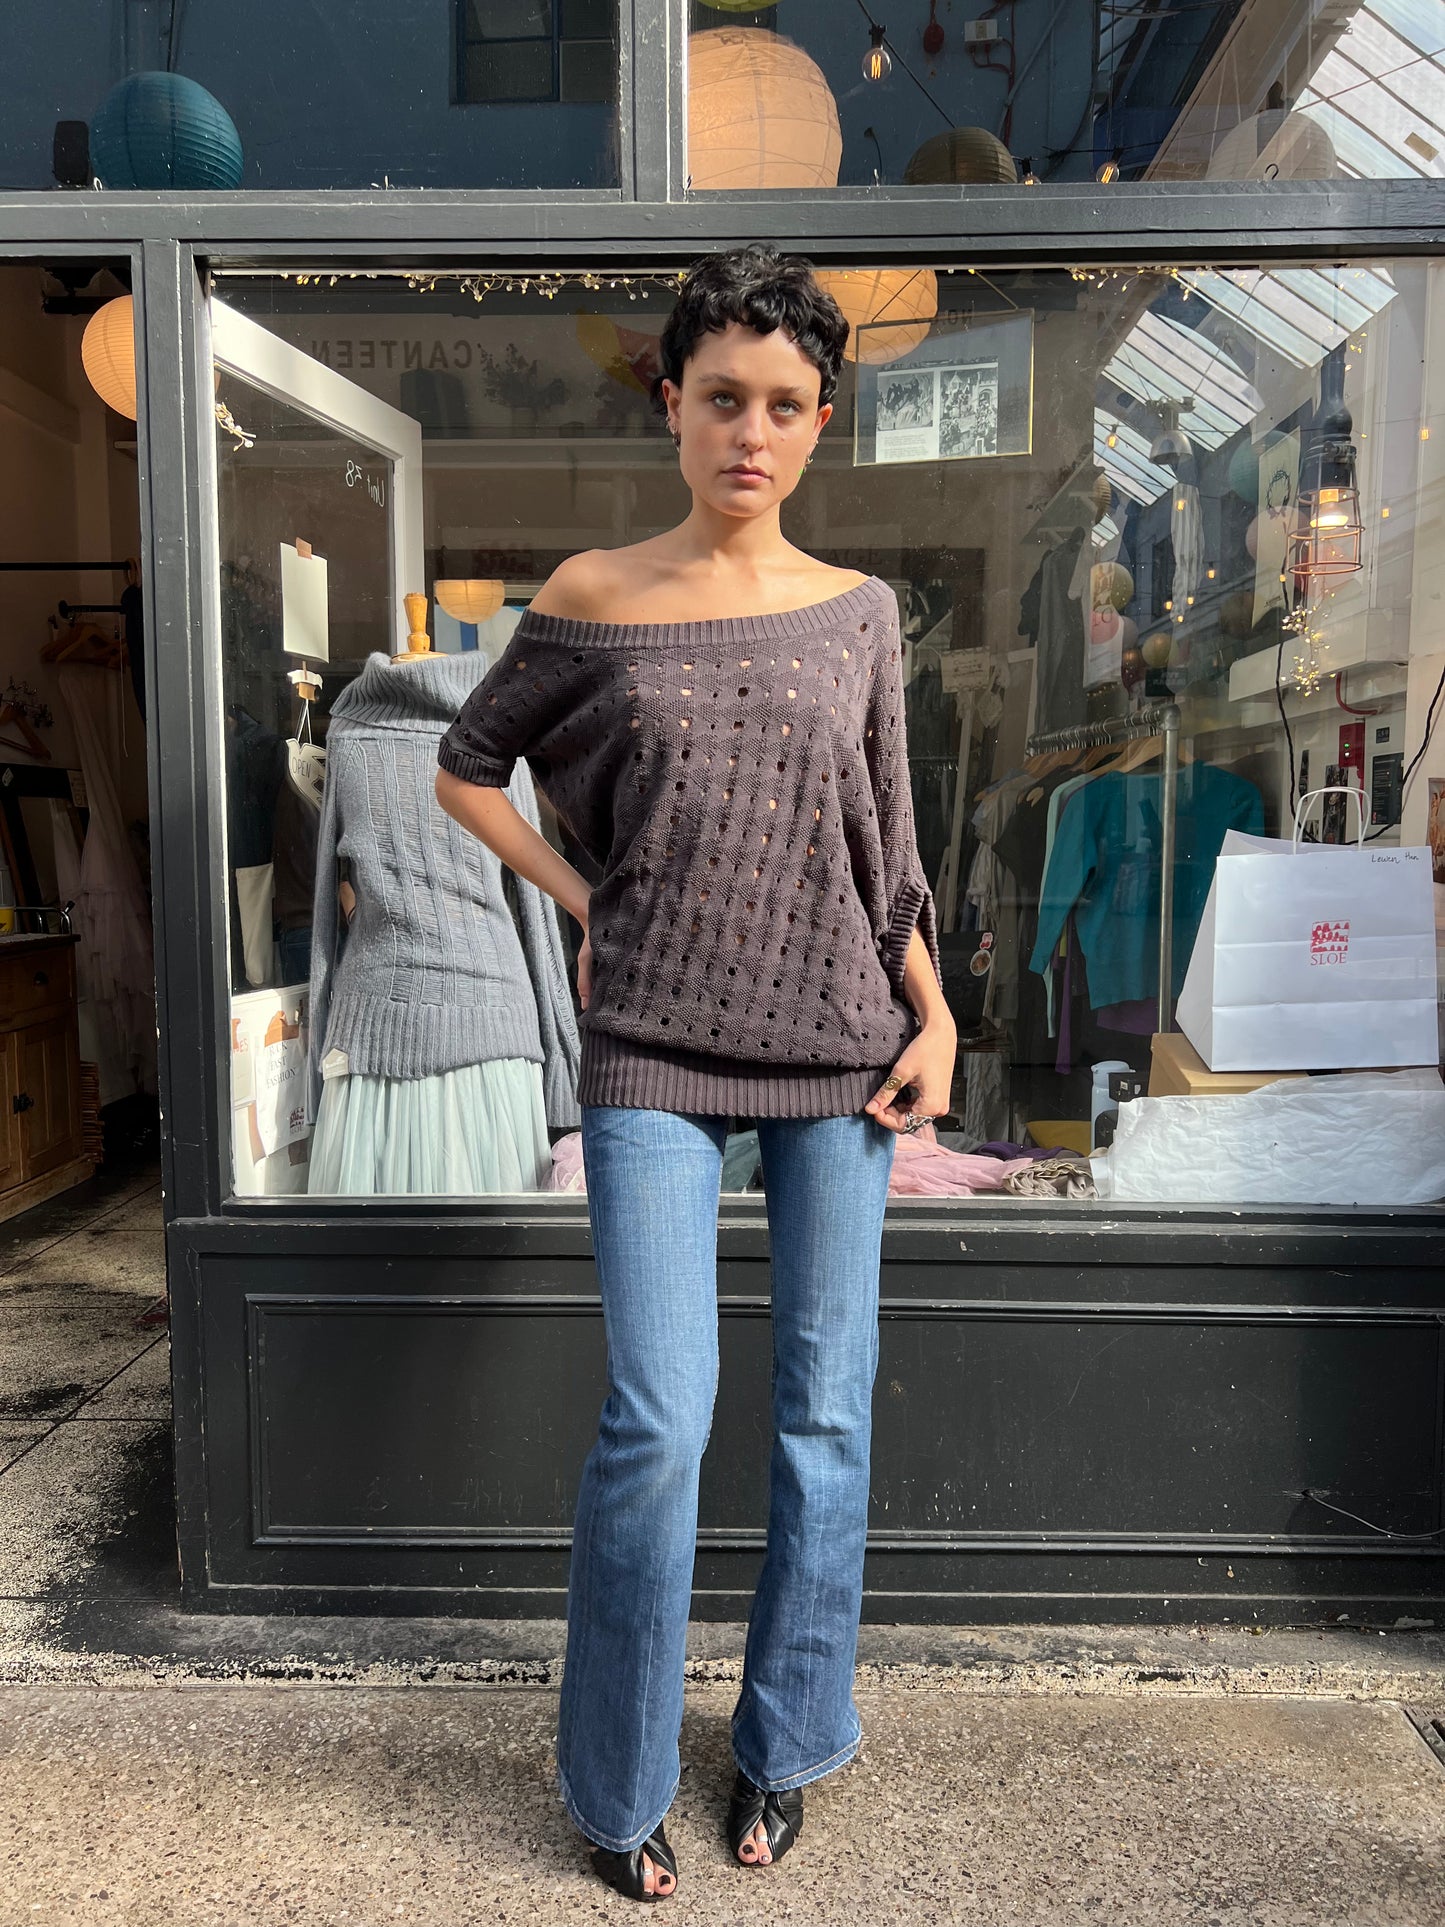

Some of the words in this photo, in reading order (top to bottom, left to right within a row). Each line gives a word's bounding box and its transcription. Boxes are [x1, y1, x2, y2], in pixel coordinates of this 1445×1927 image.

[291, 756, 311, 779] OPEN
[1310, 952, 1347, 966] SLOE
[265, 1066, 298, 1089] FASHION
